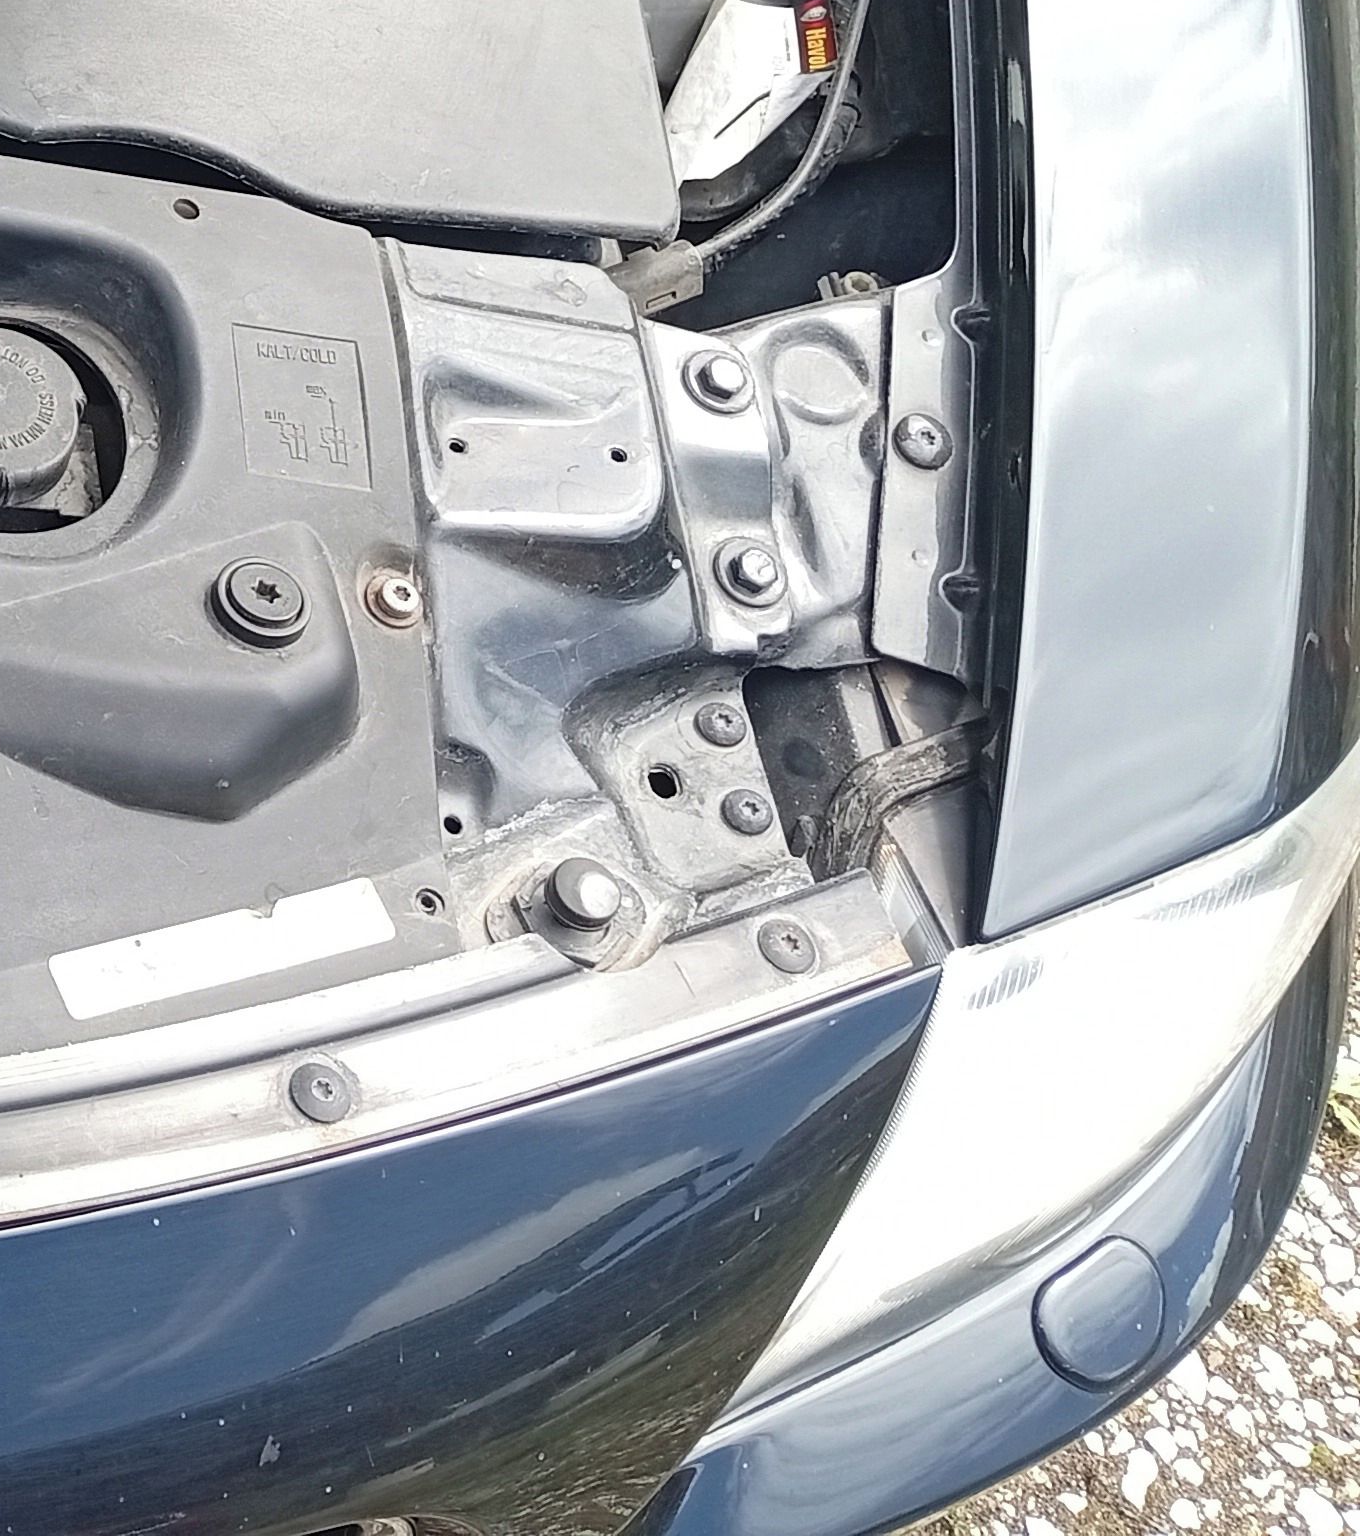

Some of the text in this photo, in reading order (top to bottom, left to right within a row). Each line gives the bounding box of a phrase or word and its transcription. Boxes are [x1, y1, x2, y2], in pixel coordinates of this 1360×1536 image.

[1, 348, 29, 369] NOT
[25, 367, 47, 384] DO
[9, 421, 47, 449] WENN
[37, 391, 56, 426] HEISS
